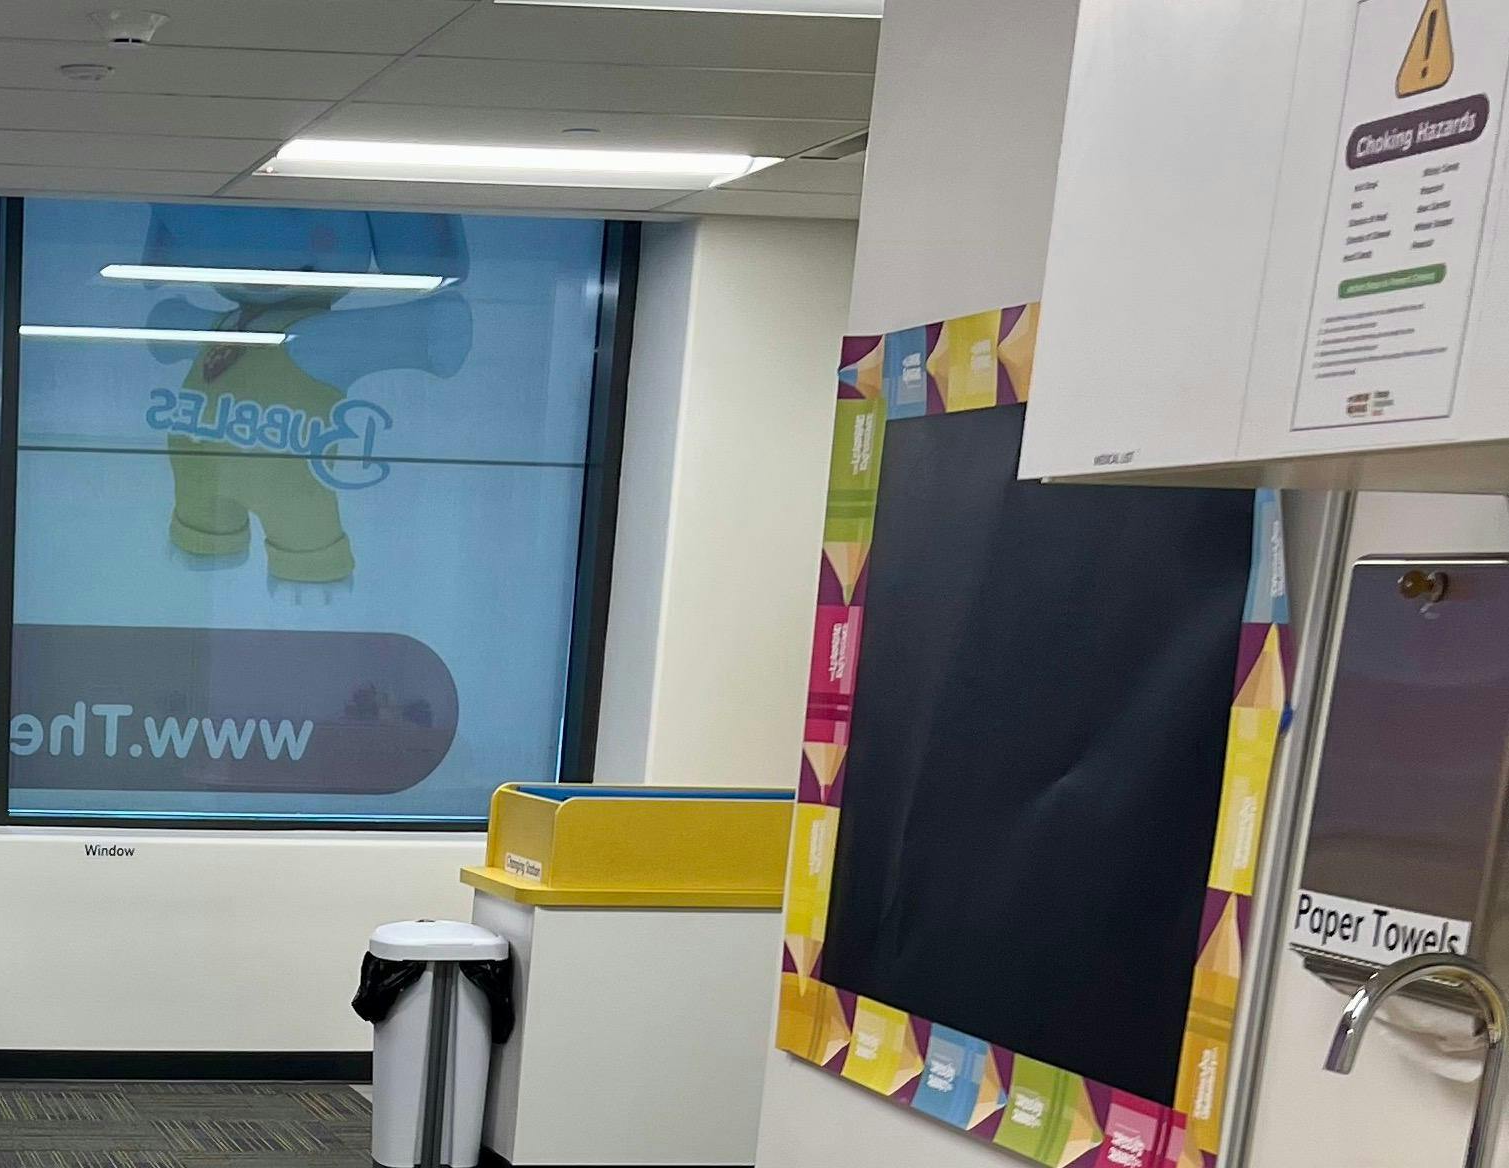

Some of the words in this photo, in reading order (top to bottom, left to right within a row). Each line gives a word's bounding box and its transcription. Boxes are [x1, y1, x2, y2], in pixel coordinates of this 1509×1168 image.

[1355, 127, 1414, 158] Choking
[1415, 109, 1477, 143] Hazards
[84, 843, 136, 857] Window
[1294, 894, 1364, 946] Paper
[1372, 909, 1462, 955] Towels
